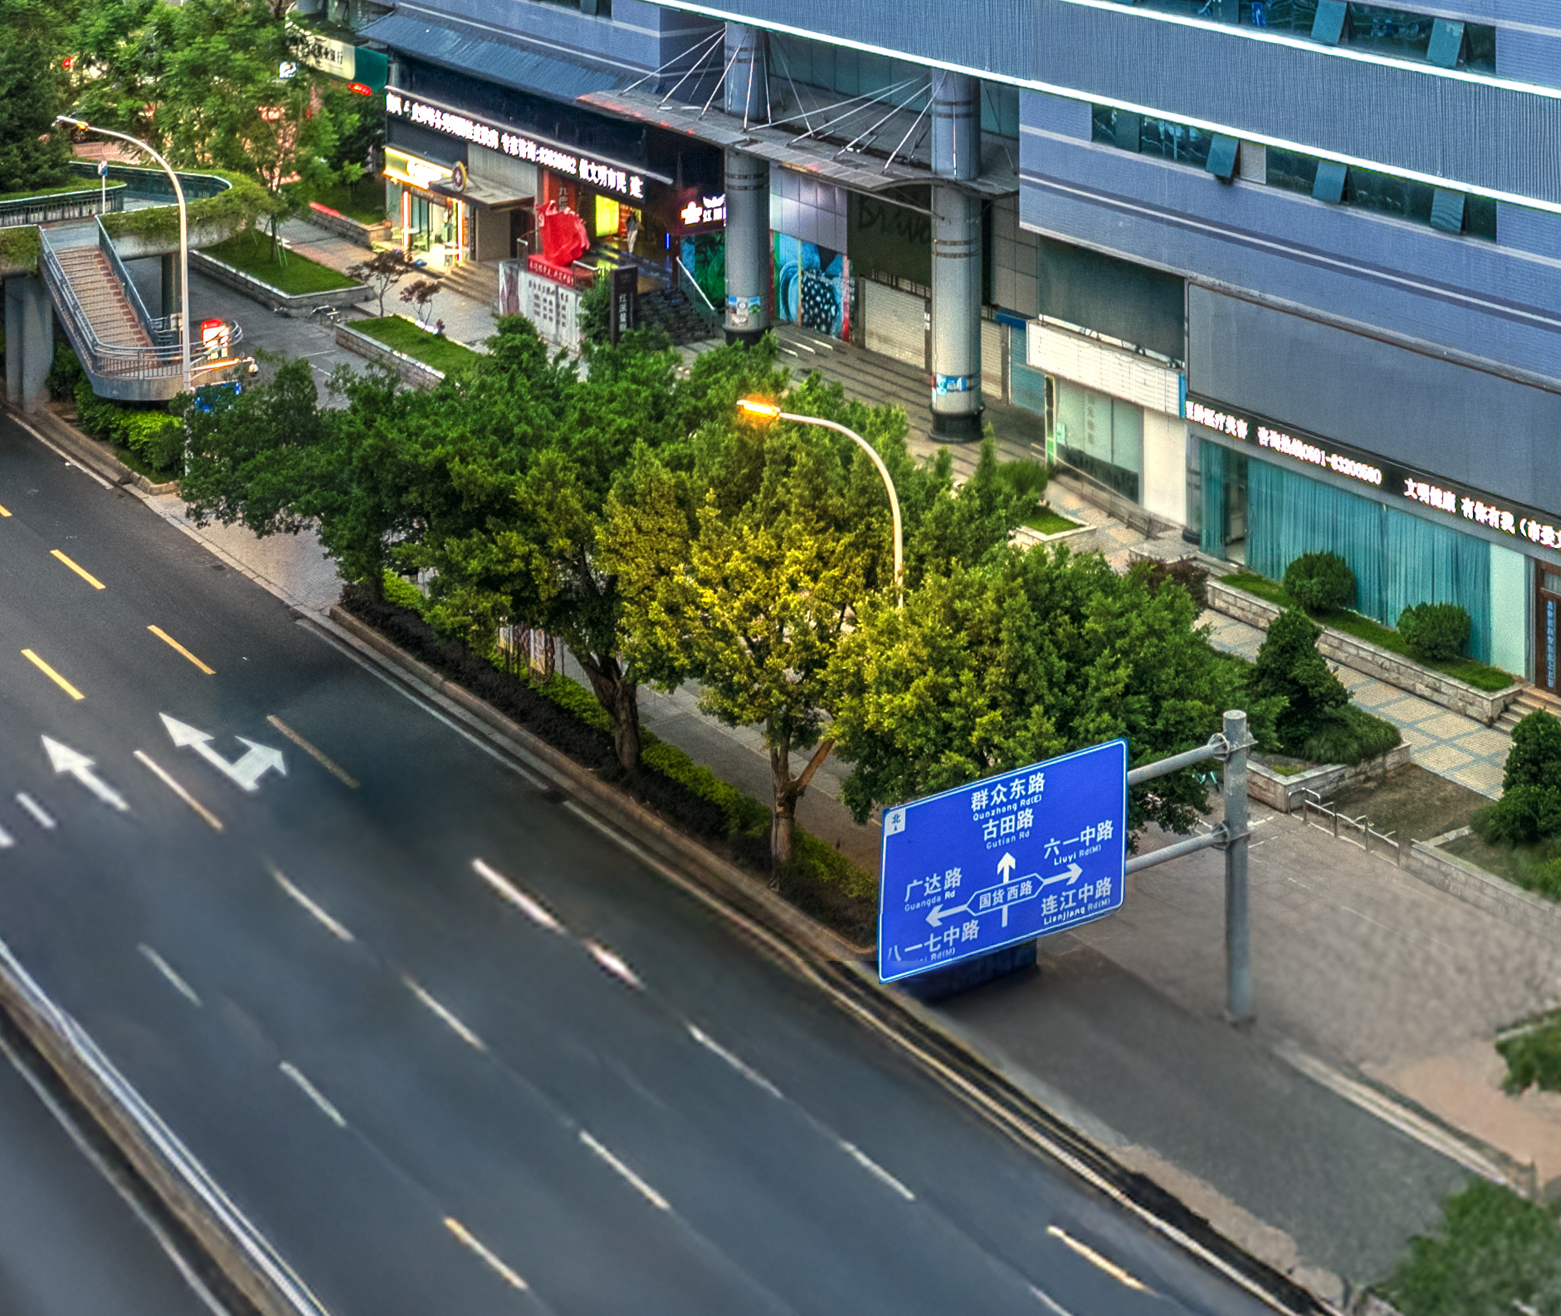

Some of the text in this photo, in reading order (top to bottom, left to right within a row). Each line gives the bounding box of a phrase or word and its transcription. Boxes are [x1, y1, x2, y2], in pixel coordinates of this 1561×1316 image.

[1404, 478, 1456, 513] 文明健康
[971, 772, 1045, 812] 群众东路
[973, 794, 1043, 822] Qunzhong Rd(E)
[982, 808, 1034, 841] 古田路
[986, 830, 1030, 850] Gutian Rd
[1044, 819, 1114, 859] 六一中路
[1054, 845, 1102, 866] Liuyi Rd(M)
[904, 867, 962, 903] 广达路
[904, 890, 956, 912] Guangda Rd
[979, 880, 1033, 910] 国货西路
[1041, 876, 1112, 917] 连江中路
[1043, 898, 1111, 925] Lianjiang Rd(M)
[887, 919, 980, 962] 八一七中路
